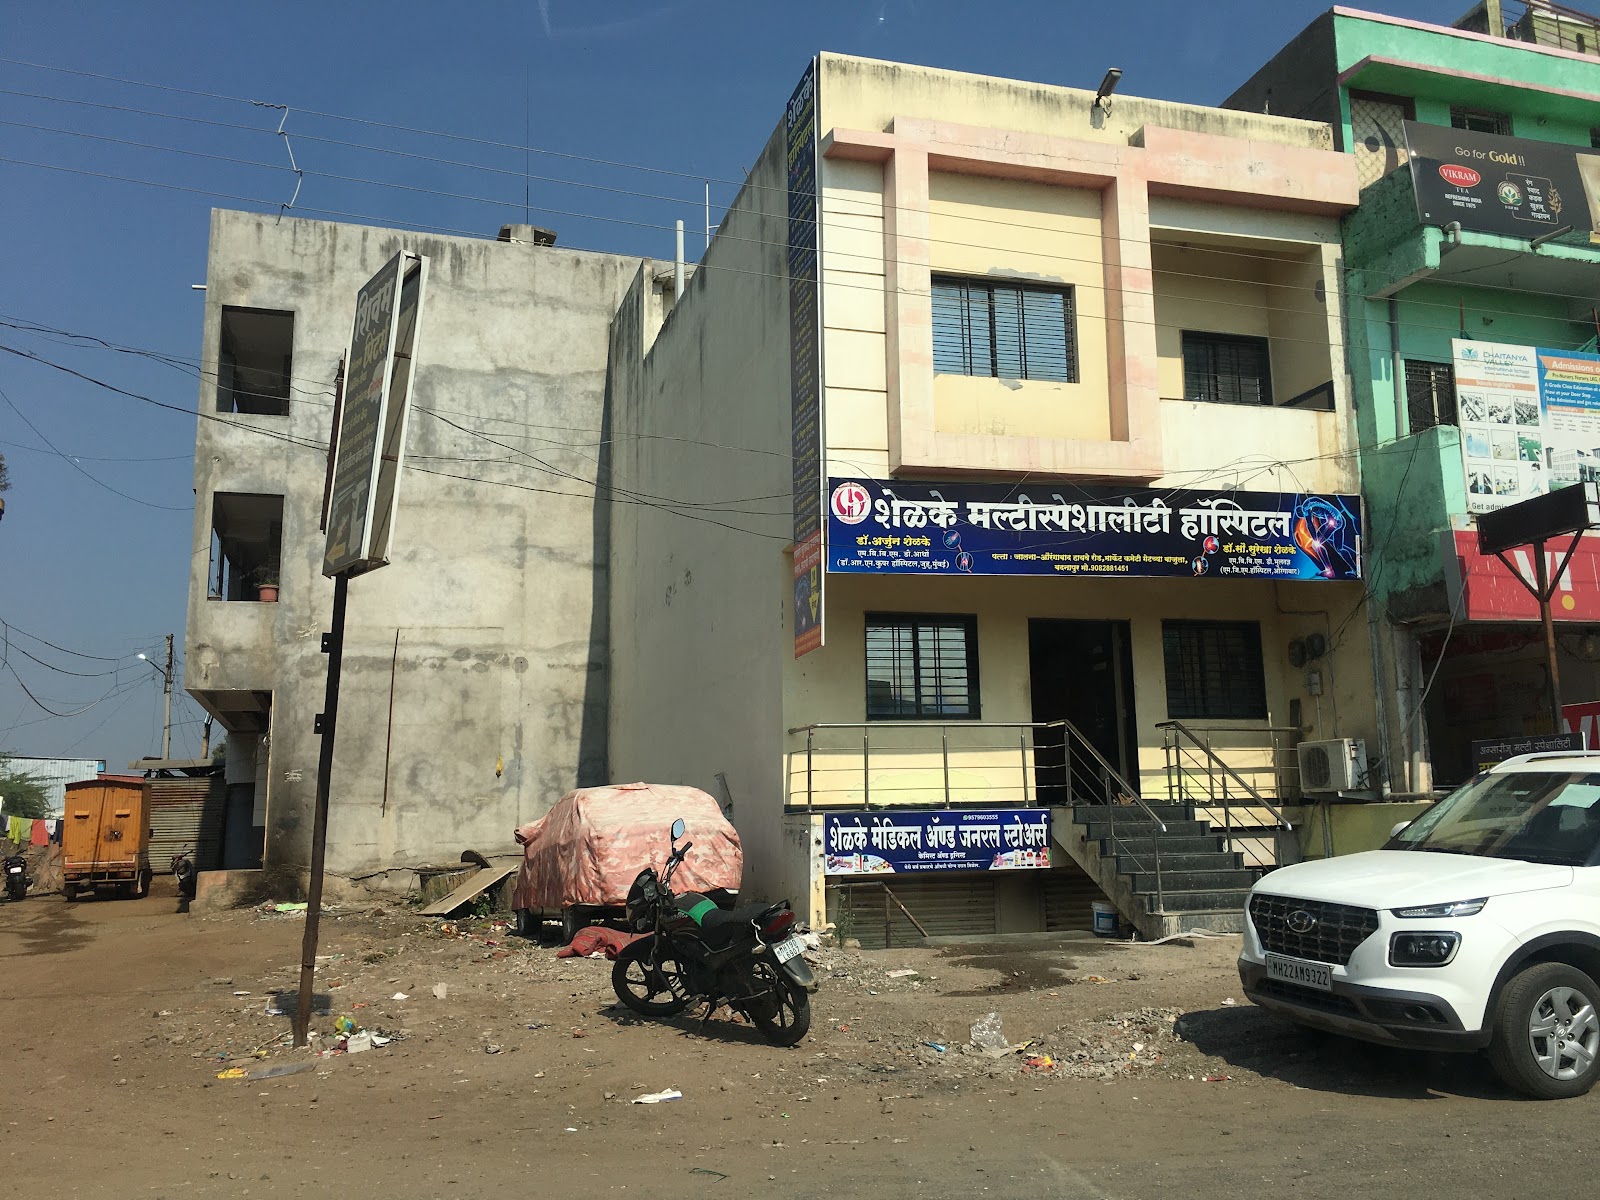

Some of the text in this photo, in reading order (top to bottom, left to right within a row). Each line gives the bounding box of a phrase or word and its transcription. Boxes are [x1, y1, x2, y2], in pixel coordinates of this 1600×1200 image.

[788, 73, 813, 128] शेळके
[1455, 146, 1470, 158] Go
[1473, 149, 1486, 160] for
[1489, 150, 1518, 165] Gold
[1442, 168, 1477, 182] VIKRAM
[1483, 351, 1528, 362] CHAITANYA
[1552, 361, 1594, 372] Admissions
[1472, 502, 1484, 510] Get
[874, 489, 958, 529] शेळके
[966, 494, 1172, 534] मल्टीस्पेशालीटी
[1179, 498, 1292, 541] हॉस्पिटल
[856, 534, 931, 548] डॉ.अर्जुन शेळके
[1222, 542, 1296, 556] डॉ.सौ.सुरेखा शेळके
[1514, 740, 1532, 752] मल्टी
[1535, 737, 1571, 749] स्पेशालिटी
[830, 817, 868, 852] शेळके
[871, 817, 922, 850] मेडिकल
[959, 825, 1001, 848] जनरल
[1004, 814, 1048, 847] स्टोअर्स
[1272, 960, 1328, 986] MH22AM9322
